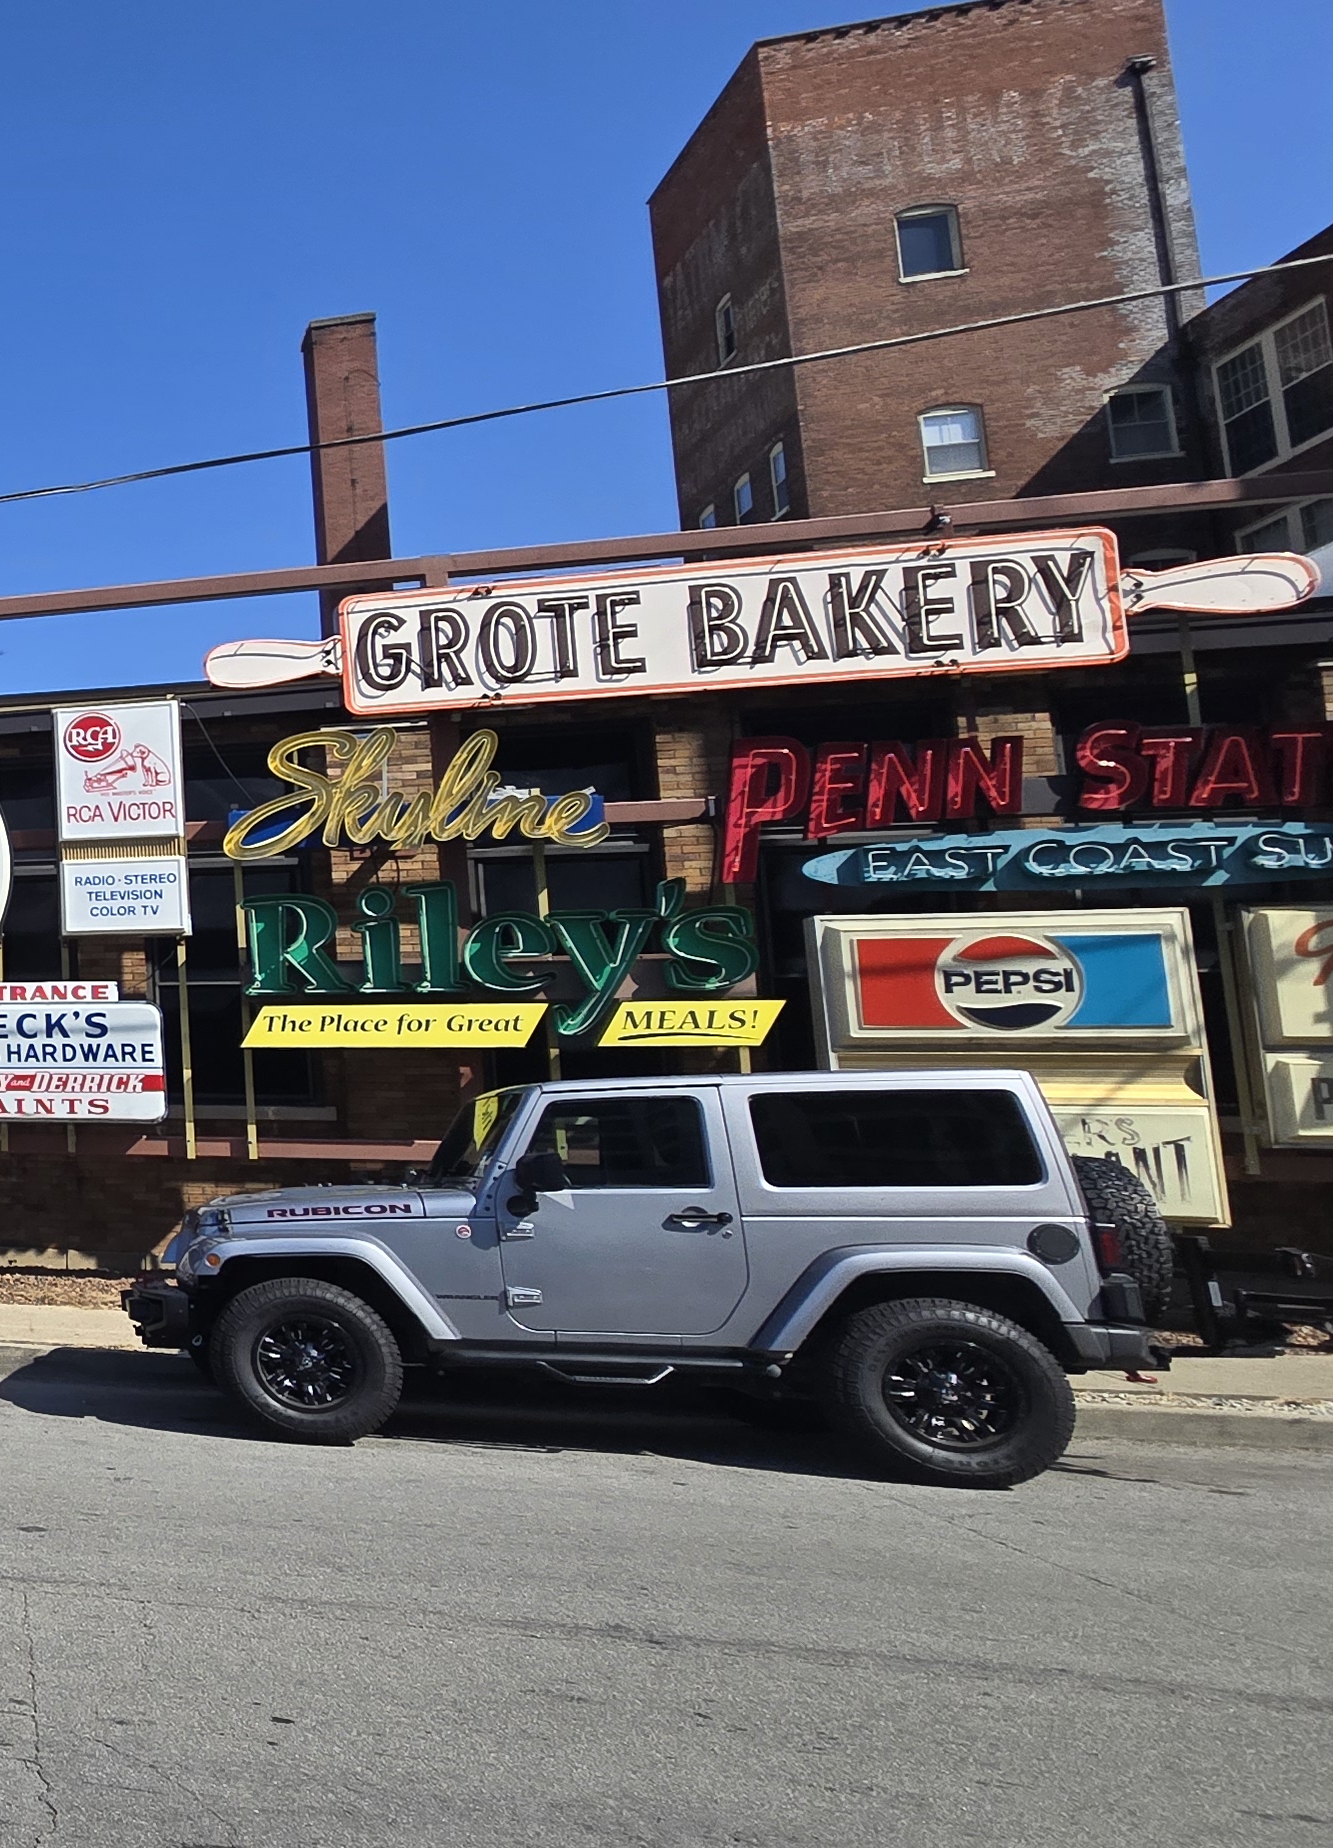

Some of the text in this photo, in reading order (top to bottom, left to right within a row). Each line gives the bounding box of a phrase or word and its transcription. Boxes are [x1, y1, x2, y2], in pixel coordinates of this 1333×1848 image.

[354, 549, 1096, 693] GROTE BAKERY
[70, 725, 117, 748] RCA
[223, 726, 610, 861] Skyline
[66, 800, 176, 824] RCA VICTOR
[722, 733, 1024, 884] PENN
[865, 846, 1008, 879] EAST
[1028, 839, 1229, 875] COAST
[74, 872, 177, 887] RADIO STEREO
[87, 889, 163, 902] TELEVISION
[90, 904, 160, 917] COLOR TV
[239, 876, 760, 1037] Riley's
[942, 967, 1076, 996] PEPSI
[263, 1012, 524, 1036] The Place for Great
[622, 1008, 759, 1033] MEALS!
[6, 1043, 156, 1063] HARDWARE
[11, 1077, 31, 1088] and
[30, 1071, 145, 1094] DERRICK
[266, 1204, 412, 1218] RUBICON
